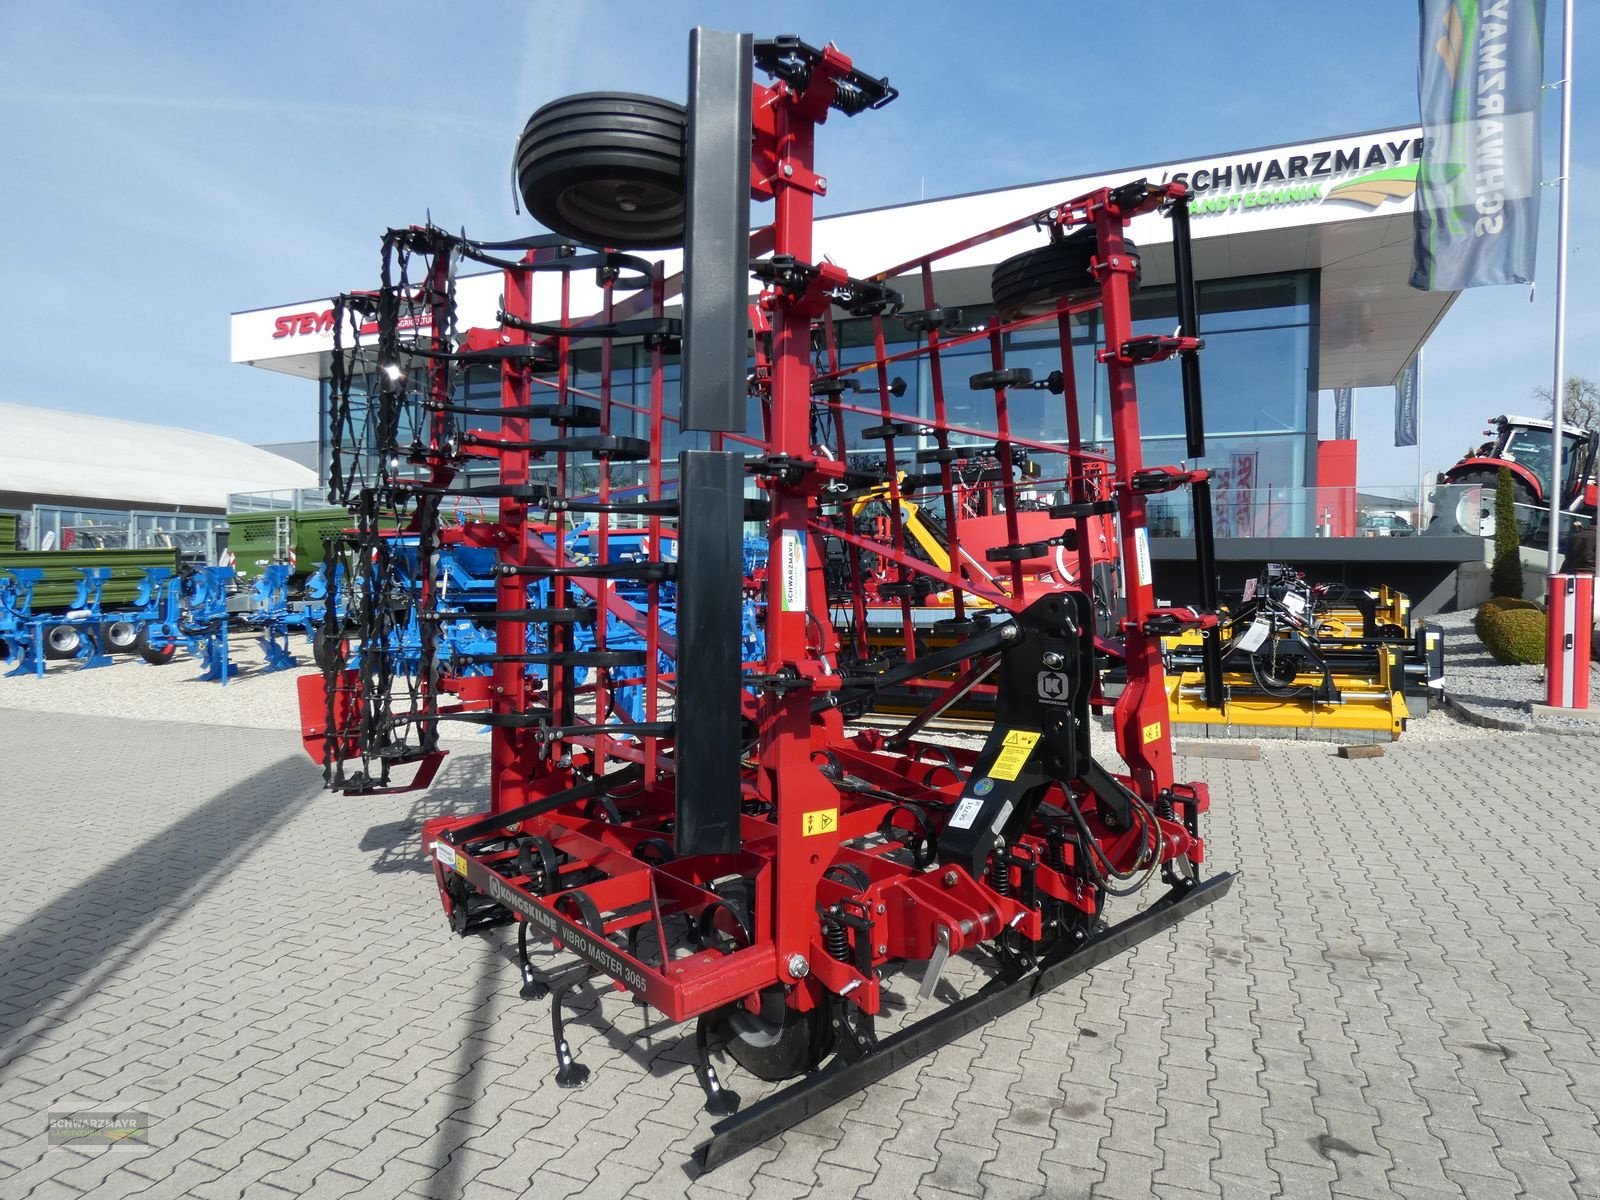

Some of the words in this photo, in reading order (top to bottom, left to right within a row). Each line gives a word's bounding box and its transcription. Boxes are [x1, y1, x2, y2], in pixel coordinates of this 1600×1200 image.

[1188, 183, 1323, 216] ANDTECHNIK
[500, 886, 558, 933] KONGSKILDE
[561, 926, 587, 951] VIBRO
[588, 944, 623, 976] MASTER
[624, 966, 648, 993] 3065
